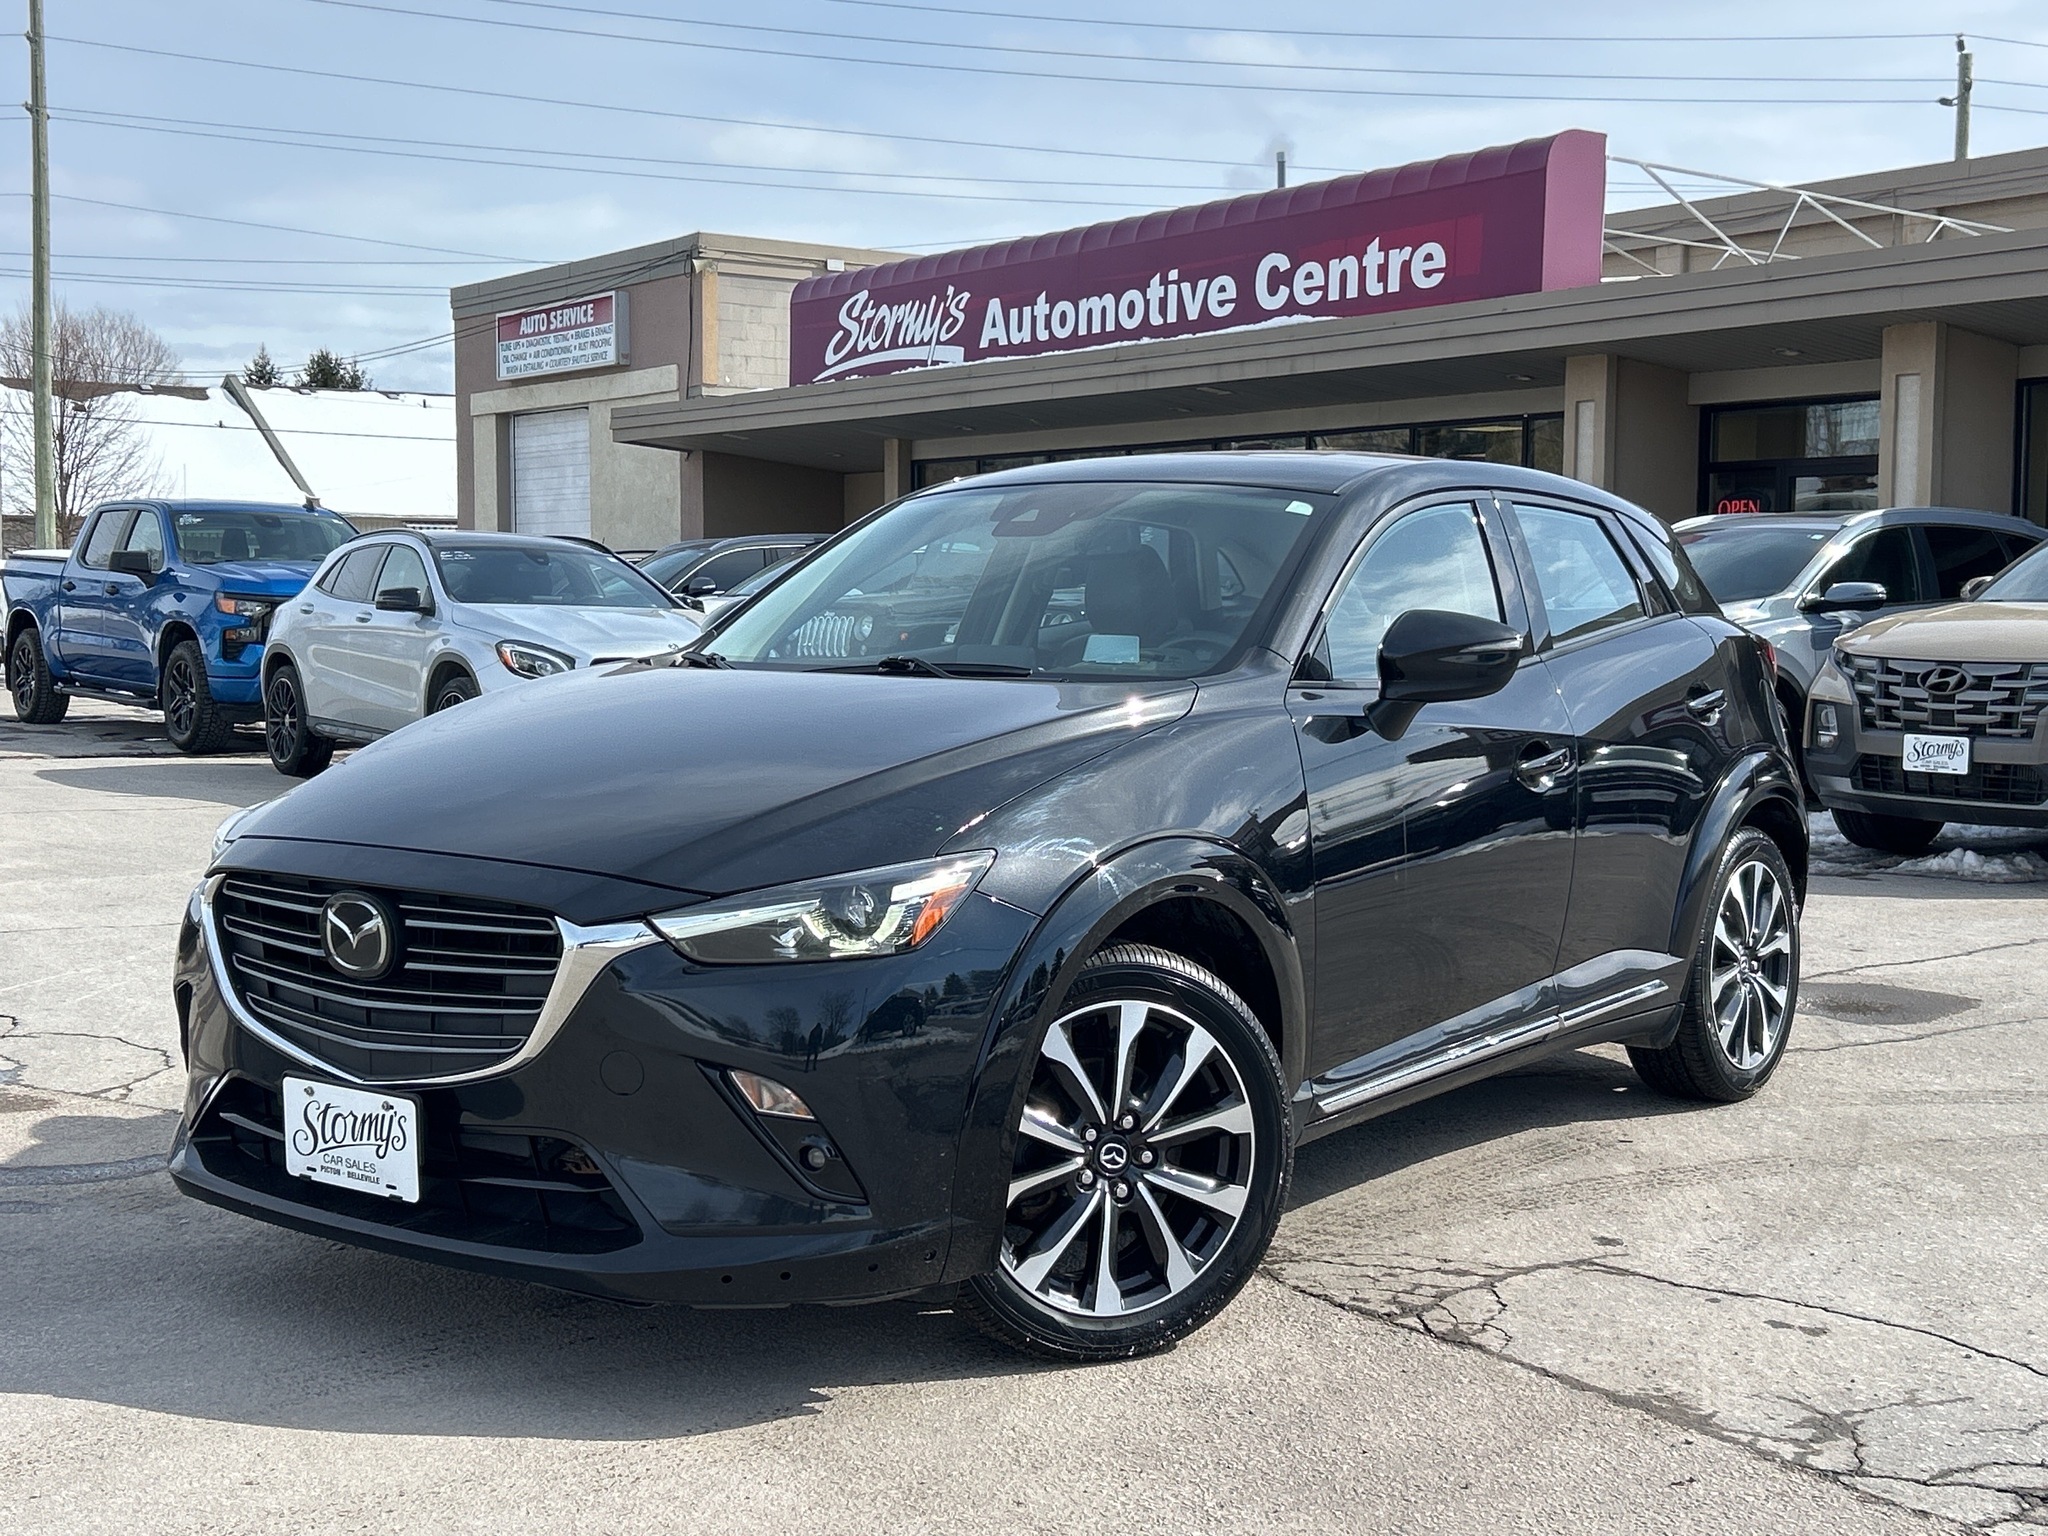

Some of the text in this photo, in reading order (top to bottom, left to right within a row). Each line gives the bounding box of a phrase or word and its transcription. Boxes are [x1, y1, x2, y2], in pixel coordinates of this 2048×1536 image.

[825, 236, 1447, 366] Stormy's Automotive Centre
[519, 303, 594, 335] AUTO SERVICE
[513, 341, 521, 351] UPS
[525, 336, 552, 348] DIAGNOSTIC
[553, 333, 570, 343] TESTING
[574, 329, 590, 340] BRAKES
[595, 324, 613, 336] EXHAUST
[502, 355, 510, 364] OIL
[510, 352, 528, 362] CHANGE
[541, 345, 573, 358] CONDITIONING
[578, 341, 589, 351] RUST
[589, 337, 612, 349] PROOFING
[523, 361, 545, 372] DETAILING
[571, 353, 590, 364] SHUTTLE
[590, 350, 608, 362] SERVICE
[1718, 499, 1760, 515] OPEN
[1907, 740, 1964, 762] Stormy's
[293, 1099, 407, 1159] Stormy's
[320, 1165, 341, 1176] PICTON
[347, 1170, 380, 1184] BELLEVILLE
[323, 1153, 376, 1174] CAR SALES
